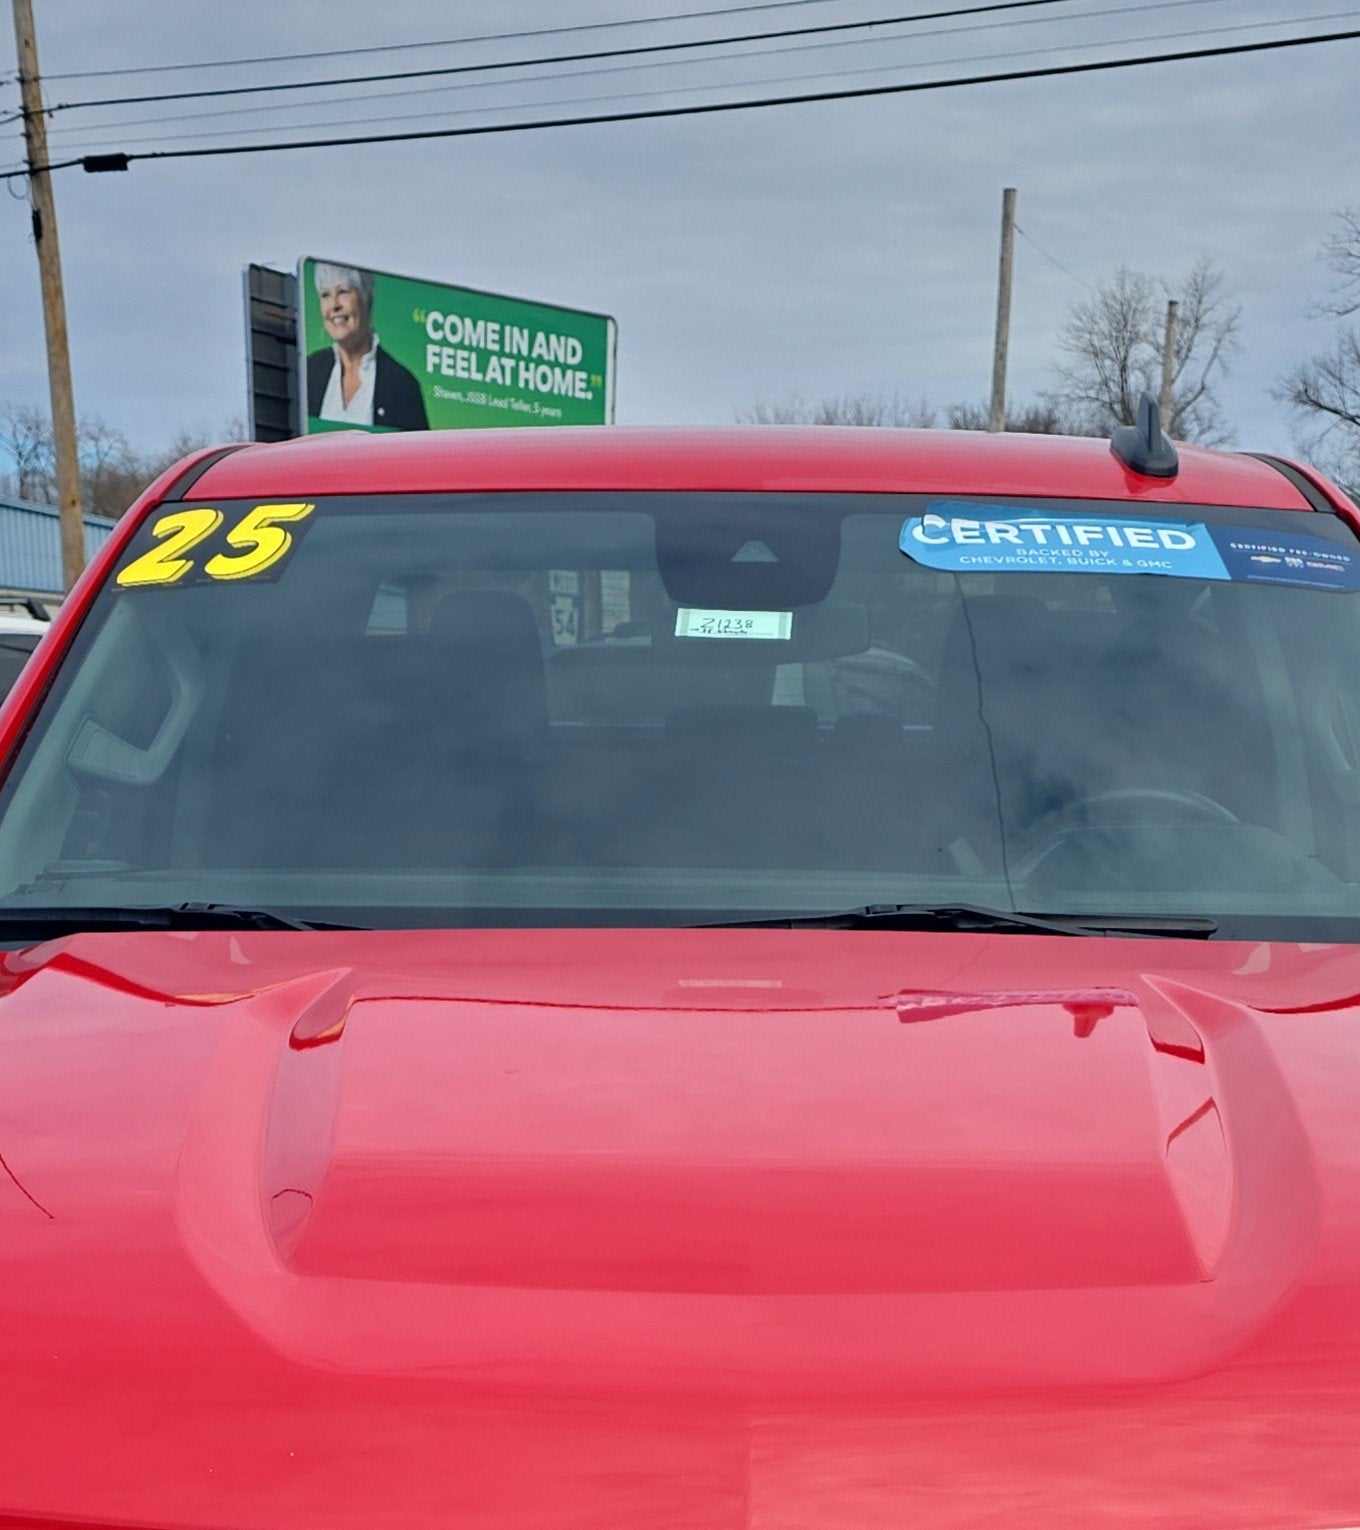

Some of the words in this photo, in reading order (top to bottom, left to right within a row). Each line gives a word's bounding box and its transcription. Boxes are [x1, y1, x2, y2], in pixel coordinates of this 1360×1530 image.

[504, 324, 530, 358] IN
[531, 331, 584, 366] AND
[425, 344, 483, 383] FEEL
[484, 355, 517, 387] AT
[116, 503, 316, 587] 25
[911, 513, 1197, 551] CERTIFIED
[958, 555, 1063, 566] CHEVROLET,
[1067, 557, 1117, 567] BUICK
[1136, 559, 1173, 569] GMC
[1016, 548, 1084, 558] BACKED
[1088, 550, 1109, 559] BY
